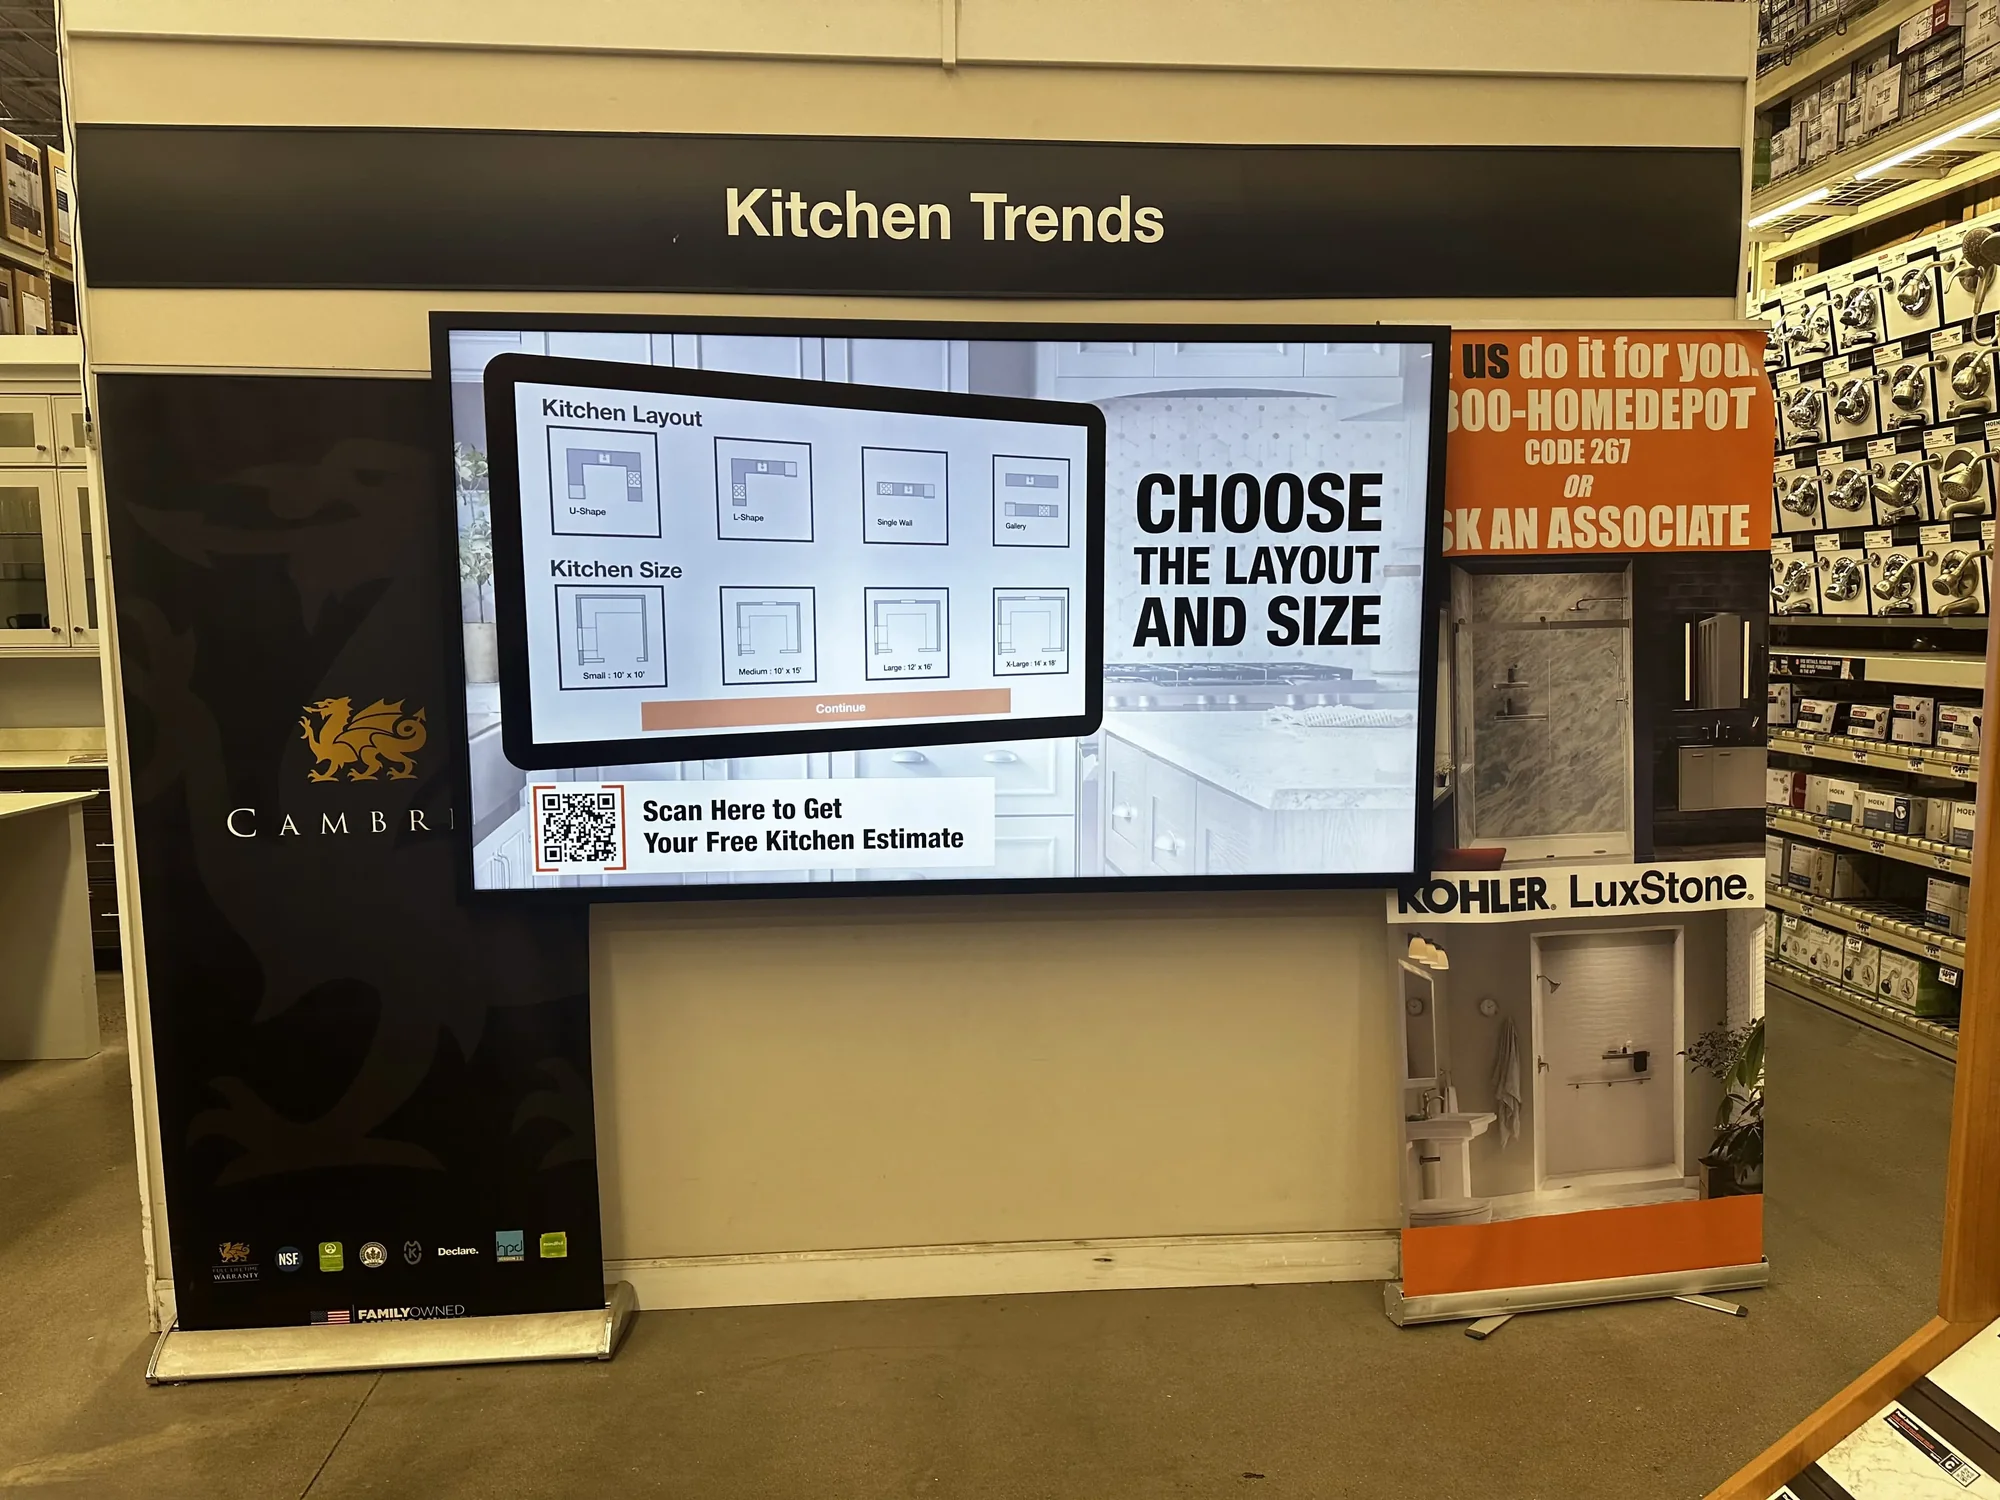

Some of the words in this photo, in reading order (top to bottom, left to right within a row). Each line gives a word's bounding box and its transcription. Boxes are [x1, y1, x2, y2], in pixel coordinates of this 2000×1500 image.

[726, 187, 951, 240] Kitchen
[970, 192, 1165, 244] Trends
[1462, 342, 1509, 379] us
[1519, 336, 1568, 379] do
[1578, 336, 1605, 379] it
[1613, 336, 1670, 379] for
[542, 398, 626, 422] Kitchen
[633, 405, 703, 428] Layout
[1524, 438, 1585, 466] CODE
[1590, 437, 1631, 464] 267
[1563, 473, 1594, 499] OR
[1136, 472, 1383, 534] CHOOSE
[569, 506, 607, 517] U-Shape
[733, 513, 765, 523] L-Shape
[877, 518, 898, 527] Single
[898, 519, 913, 527] Wall
[1005, 522, 1027, 531] Gallery
[1490, 506, 1538, 549] AN
[1547, 504, 1750, 549] ASSOCIATE
[550, 559, 633, 578] Kitchen
[640, 561, 683, 579] Size
[1133, 546, 1210, 585] THE
[1226, 545, 1380, 585] LAYOUT
[1133, 596, 1247, 647] AND
[1267, 595, 1382, 647] SIZE
[738, 667, 768, 676] Medium
[792, 666, 802, 674] 15'
[883, 664, 902, 672] Large
[1006, 660, 1029, 668] X-Large
[583, 672, 606, 680] Small
[613, 671, 625, 679] 10'
[815, 702, 866, 714] Continue
[1829, 788, 1846, 796] MOEN
[1867, 798, 1885, 806] MOEN
[643, 800, 702, 822] Scan
[712, 799, 766, 820] Here
[772, 798, 796, 820] to
[804, 798, 842, 819] Get
[643, 831, 698, 853] Your
[706, 831, 758, 852] Free
[766, 829, 854, 851] Kitchen
[864, 827, 964, 849] Estimate
[1398, 876, 1549, 914] KOHLER
[1570, 870, 1747, 908] LuxStone
[437, 1246, 479, 1256] Declare.
[278, 1252, 299, 1266] NSF
[213, 1272, 259, 1280] WARRANTY
